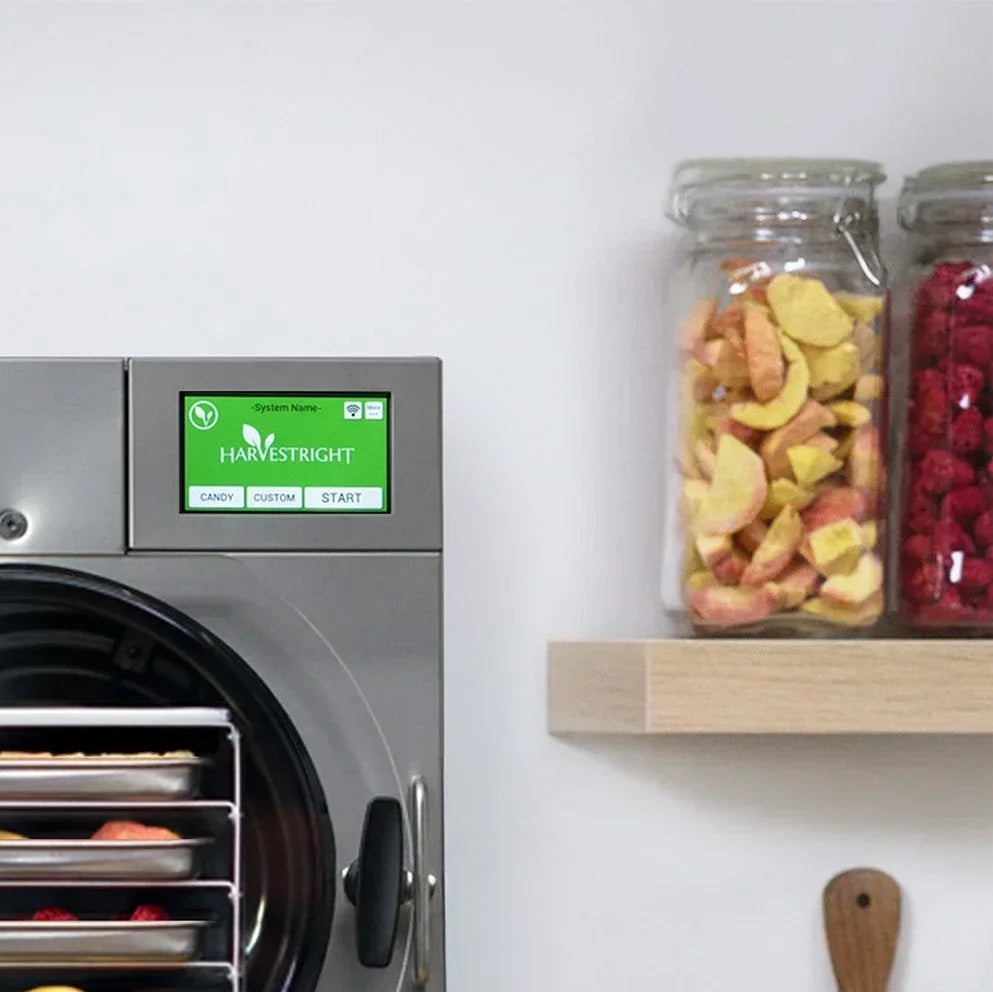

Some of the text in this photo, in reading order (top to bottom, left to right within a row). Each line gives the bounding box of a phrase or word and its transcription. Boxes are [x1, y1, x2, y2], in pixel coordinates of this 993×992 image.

[220, 446, 355, 464] HARVESTRIGHT
[200, 492, 234, 502] CANDY
[253, 493, 296, 502] CUSTOM
[321, 492, 362, 504] START
